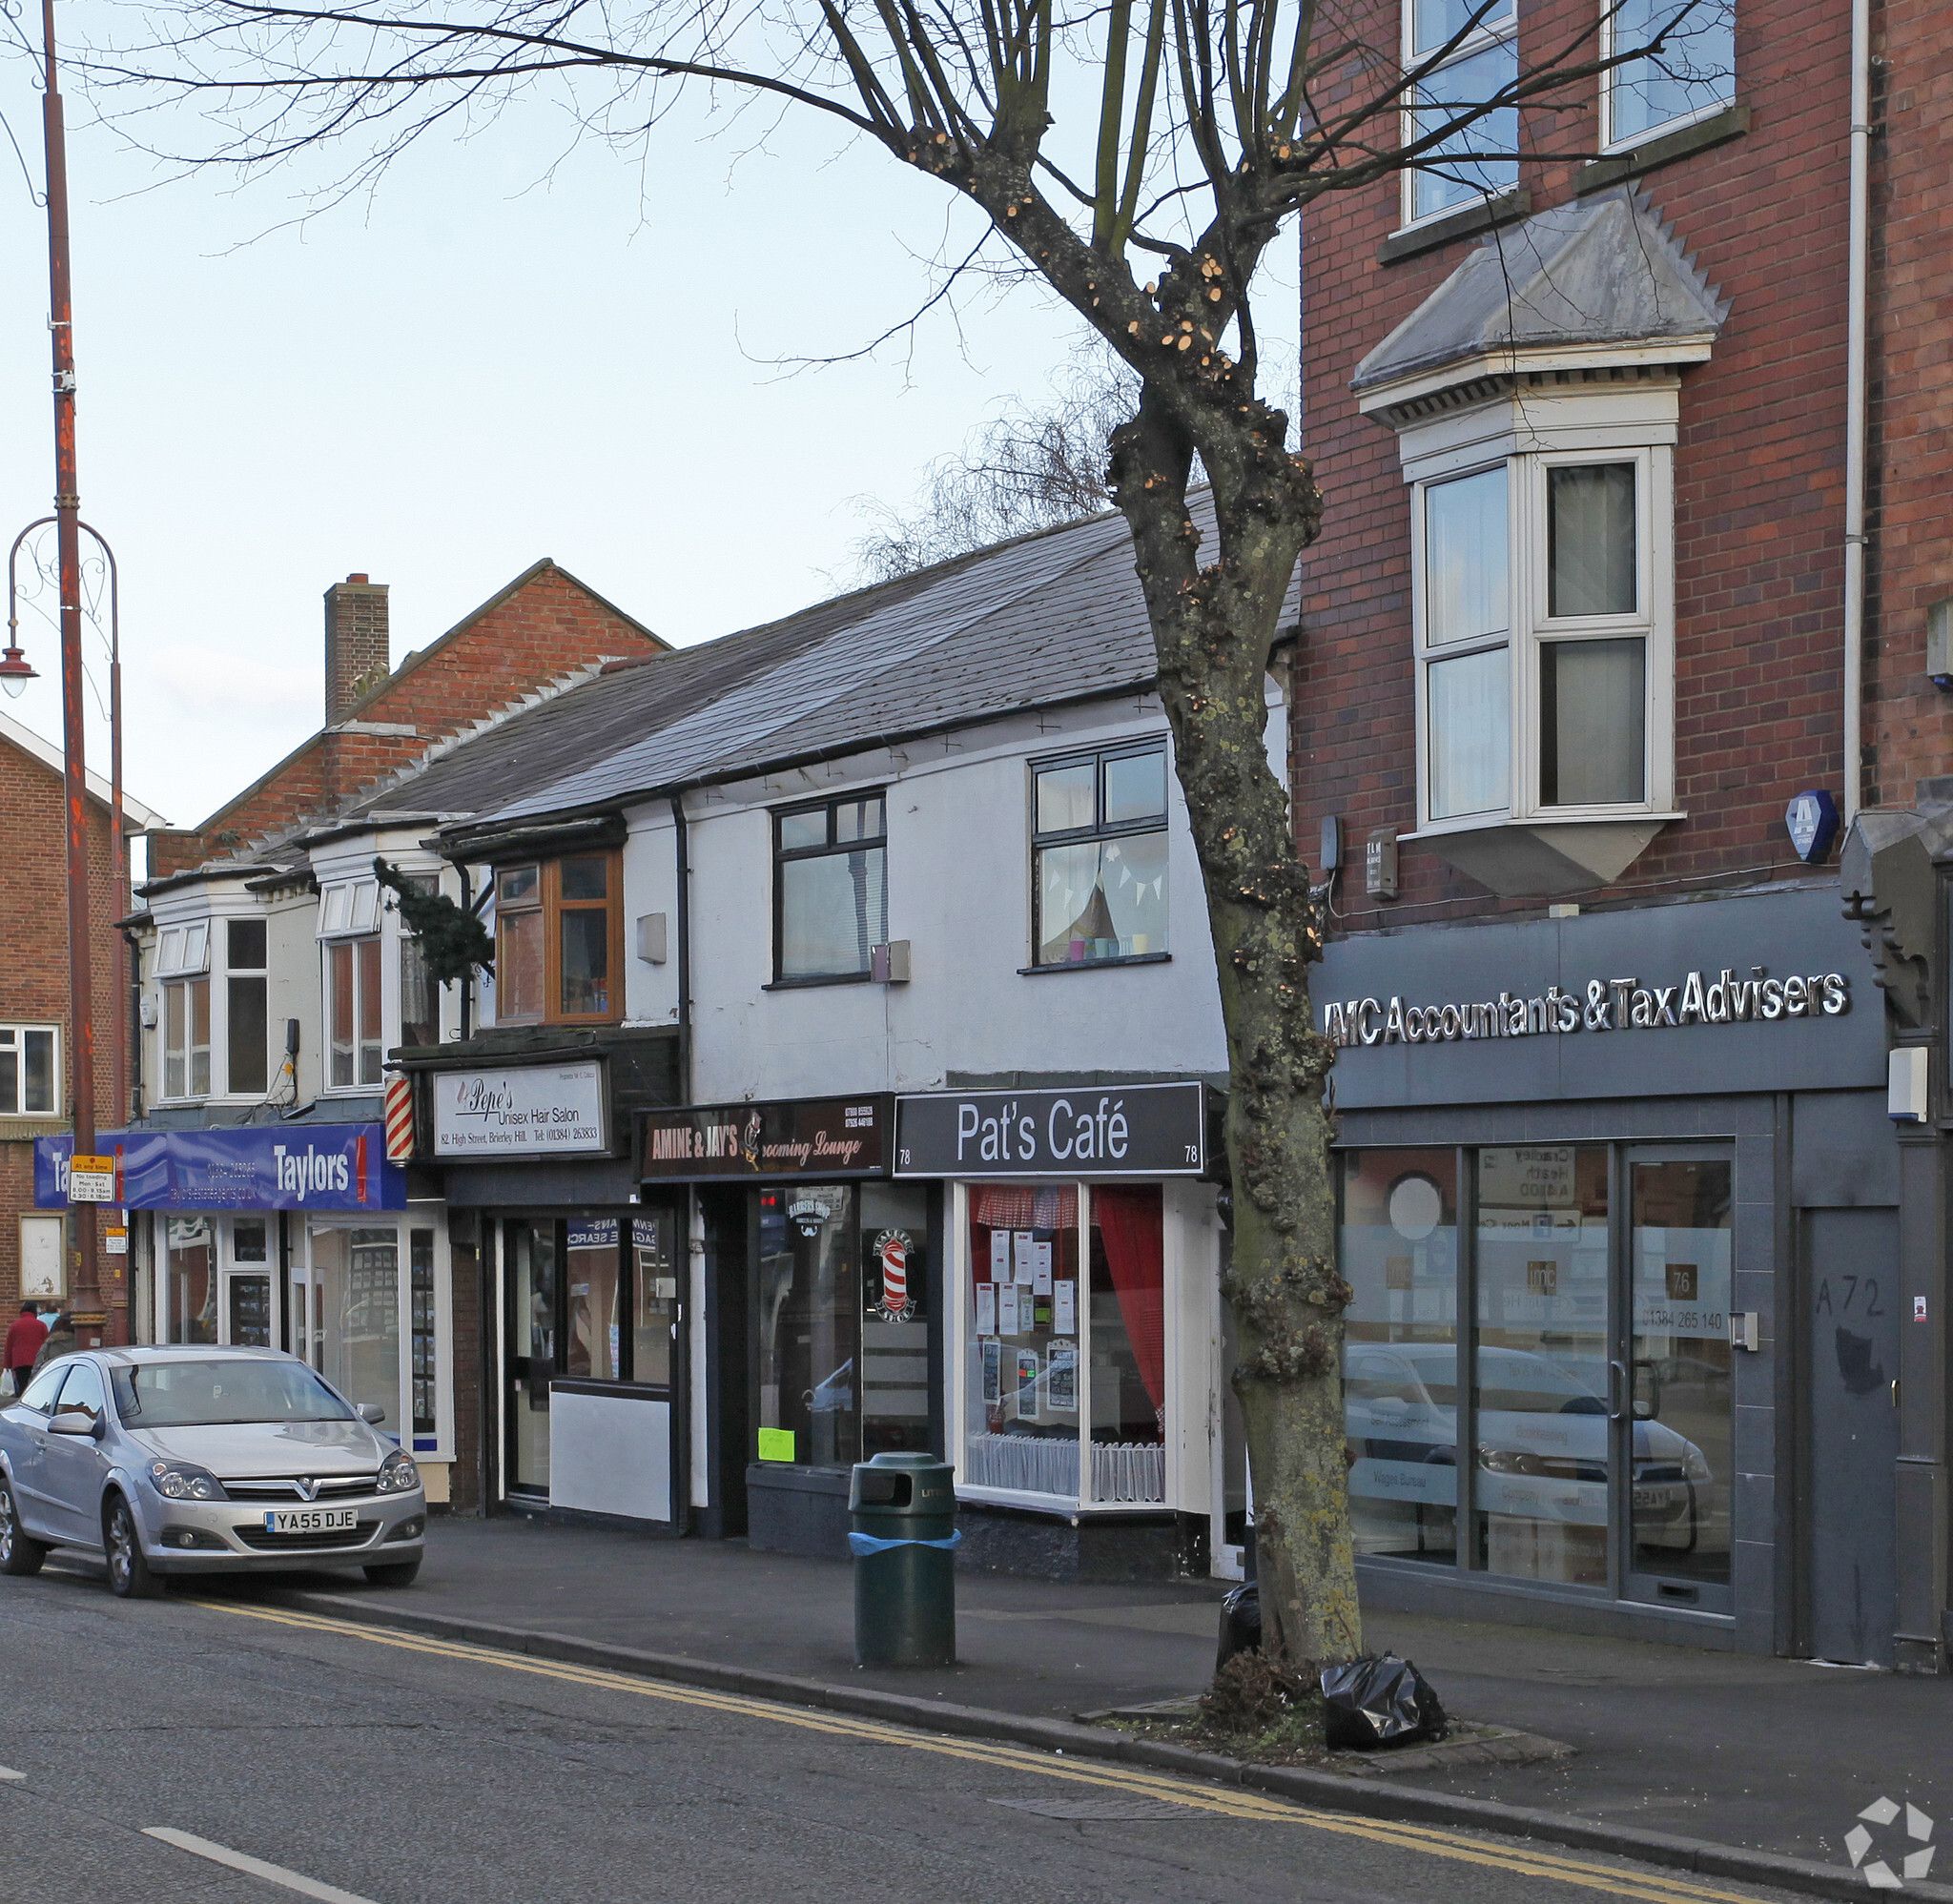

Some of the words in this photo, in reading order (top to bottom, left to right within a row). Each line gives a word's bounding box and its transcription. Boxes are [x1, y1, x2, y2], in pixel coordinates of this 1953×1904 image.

[1384, 986, 1580, 1044] Accountants
[1583, 979, 1613, 1031] &
[1610, 977, 1677, 1029] Tax
[1678, 966, 1849, 1025] Advisers
[469, 1078, 513, 1122] Pepe's
[499, 1111, 528, 1125] Unisex
[531, 1109, 549, 1123] Hair
[552, 1107, 580, 1122] Salon
[452, 1133, 466, 1146] High
[489, 1131, 512, 1145] Brierley
[957, 1101, 1036, 1160] Pat's
[1049, 1097, 1128, 1159] Café
[652, 1127, 692, 1159] AMINE
[694, 1131, 704, 1158] &
[706, 1124, 737, 1157] JAY'S
[812, 1131, 862, 1165] Lounge
[1184, 1145, 1198, 1163] 78
[900, 1149, 911, 1165] 78
[274, 1144, 349, 1201] Taylors
[1673, 1272, 1690, 1292] 76
[1677, 1310, 1698, 1328] 265
[1702, 1312, 1721, 1330] 140
[1373, 1470, 1398, 1487] Wages
[1400, 1472, 1427, 1488] Bureau
[278, 1513, 321, 1529] YA55
[325, 1511, 353, 1527] DJE
